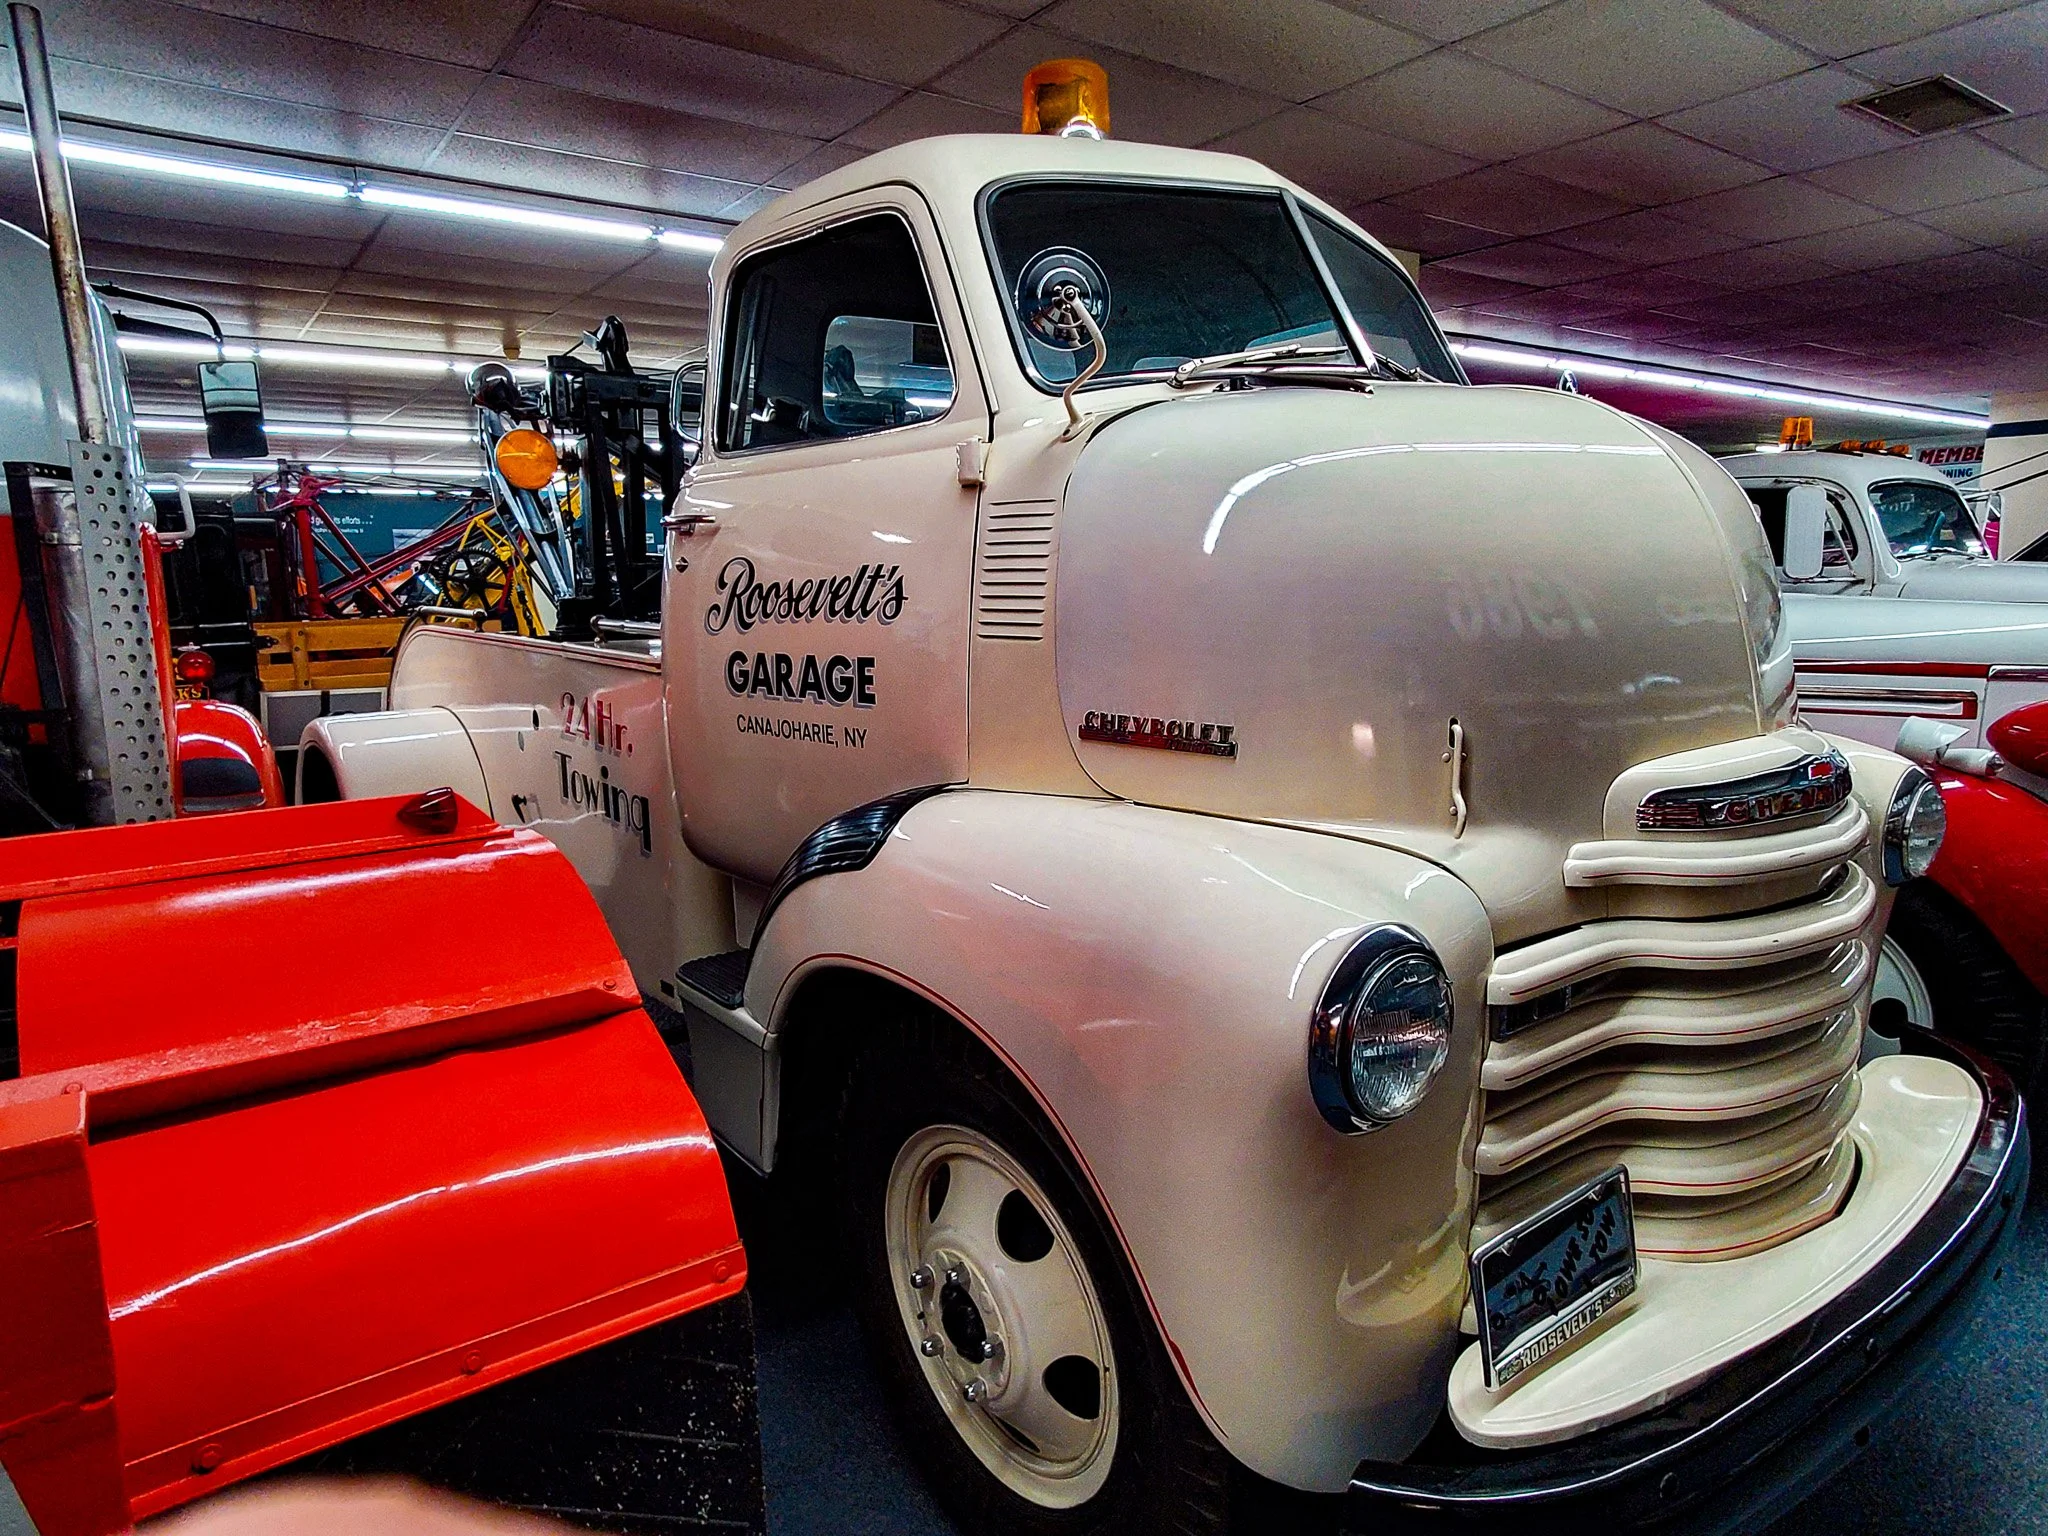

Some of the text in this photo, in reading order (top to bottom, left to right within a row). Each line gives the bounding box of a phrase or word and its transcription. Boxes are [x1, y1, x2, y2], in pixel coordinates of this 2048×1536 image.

[705, 556, 909, 635] Roosevelt's
[725, 650, 877, 708] GARAGE
[737, 713, 868, 749] CANAJOHARIE, NY
[1083, 710, 1236, 744] CHEVROLET
[1519, 1298, 1604, 1370] ROOSEVELT'S
